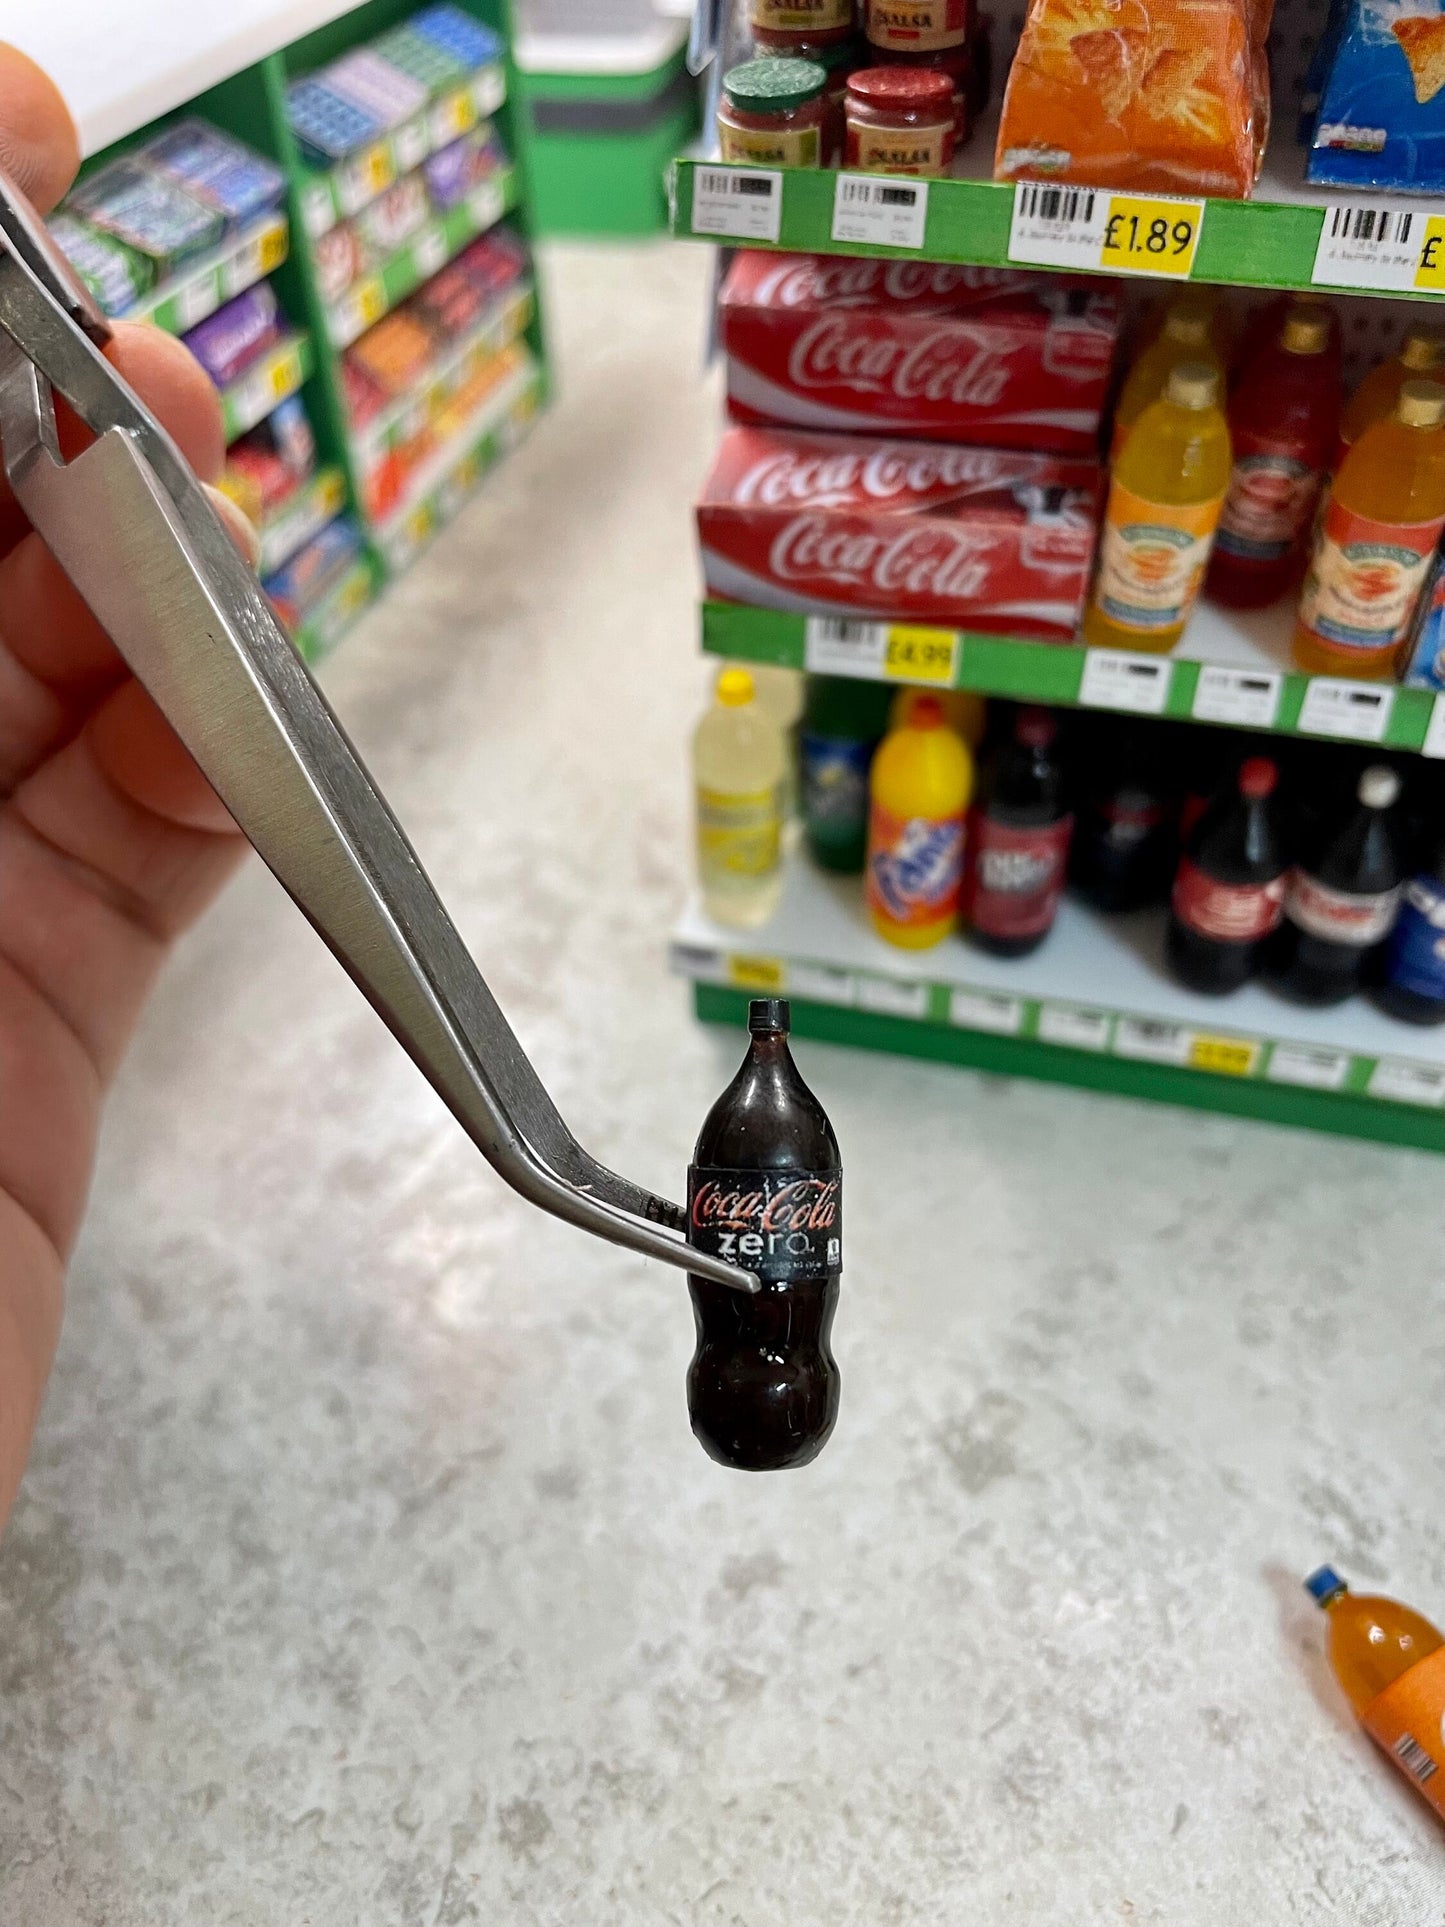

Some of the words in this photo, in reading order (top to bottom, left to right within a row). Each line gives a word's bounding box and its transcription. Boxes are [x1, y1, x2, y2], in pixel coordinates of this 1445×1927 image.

[1104, 214, 1192, 256] £1.89
[886, 640, 952, 668] £4.99
[718, 1231, 811, 1256] zero
